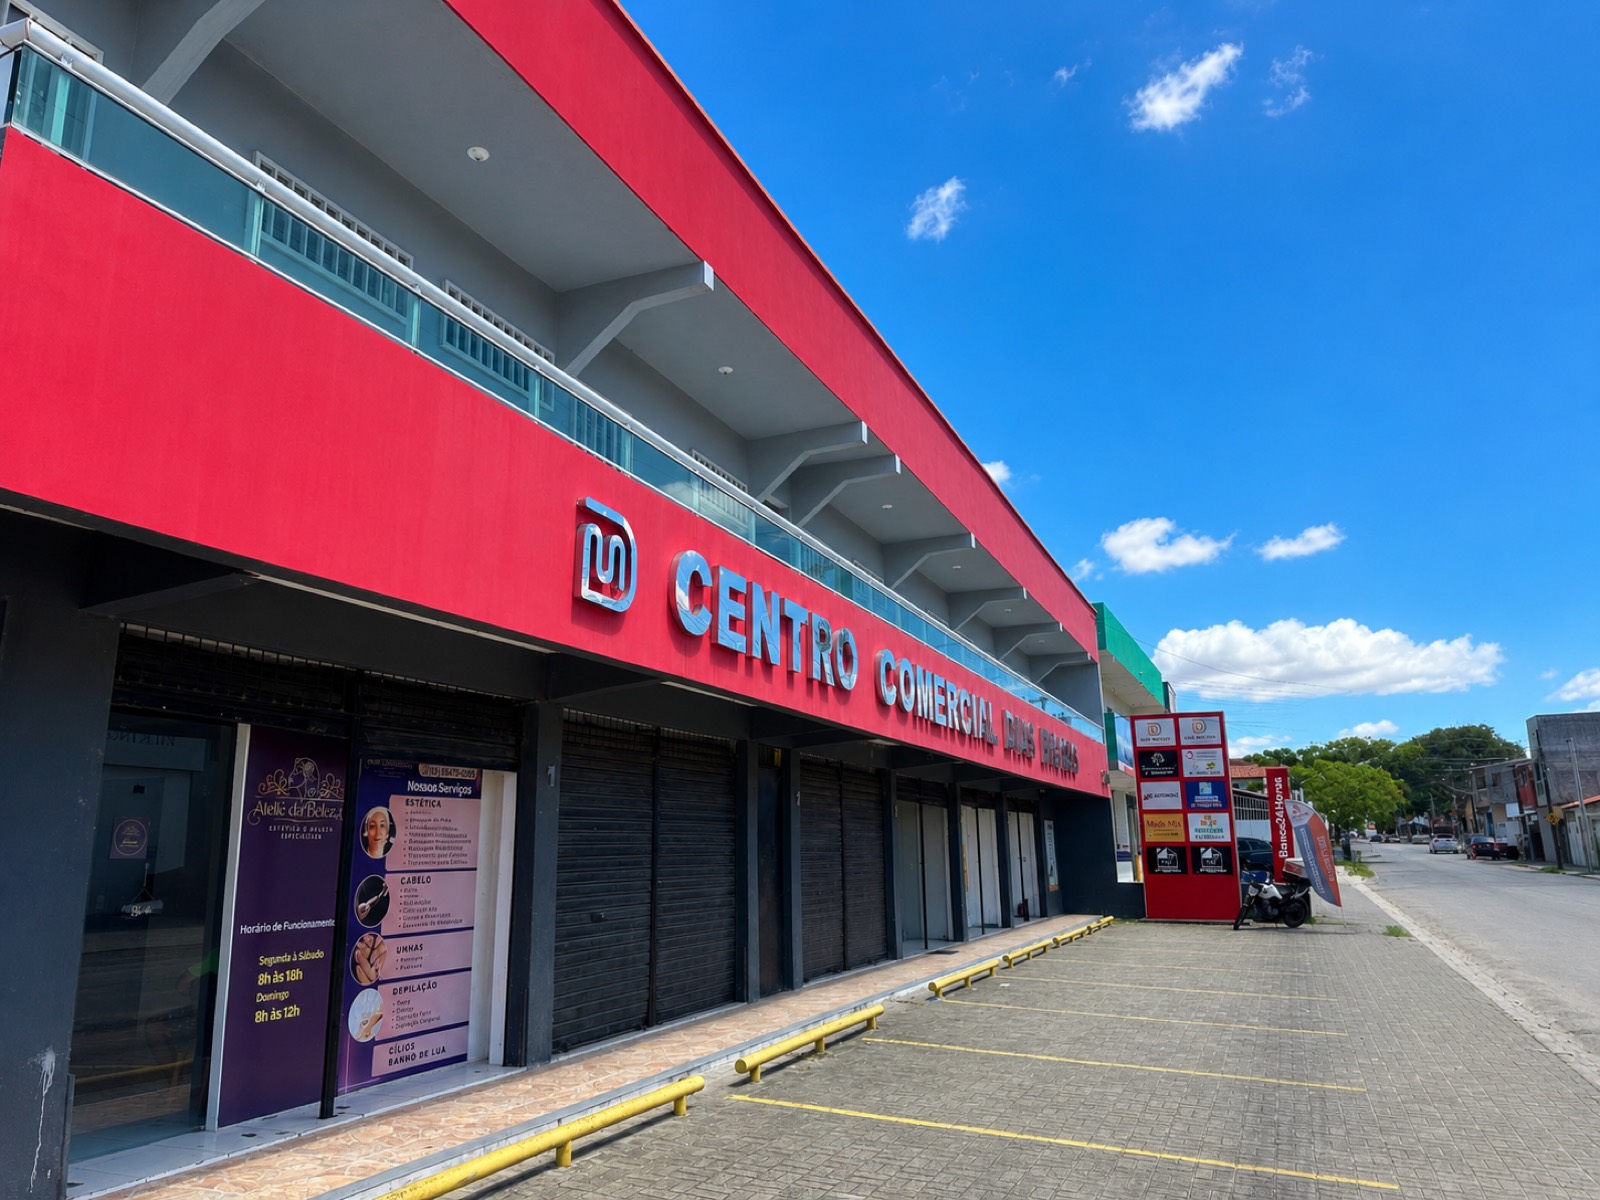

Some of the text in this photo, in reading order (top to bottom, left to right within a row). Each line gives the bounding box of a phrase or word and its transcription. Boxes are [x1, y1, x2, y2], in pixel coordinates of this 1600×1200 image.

[667, 549, 859, 691] CENTRO
[874, 648, 999, 747] COMERCIAL
[438, 781, 472, 797] Serviços
[405, 798, 442, 808] ESTÉTICA
[400, 875, 432, 885] CABELO
[240, 923, 272, 934] Horário
[272, 921, 283, 932] de
[396, 943, 424, 954] UNHAS
[259, 953, 291, 967] Segunda
[257, 968, 303, 986] 8h às 18h
[392, 980, 438, 996] DEPILAÇÃO
[256, 990, 290, 1003] Domingo
[254, 1004, 300, 1023] 8h às 12h
[388, 1042, 415, 1055] CÍLIOS
[388, 1046, 447, 1066] BANHO DE LUA
